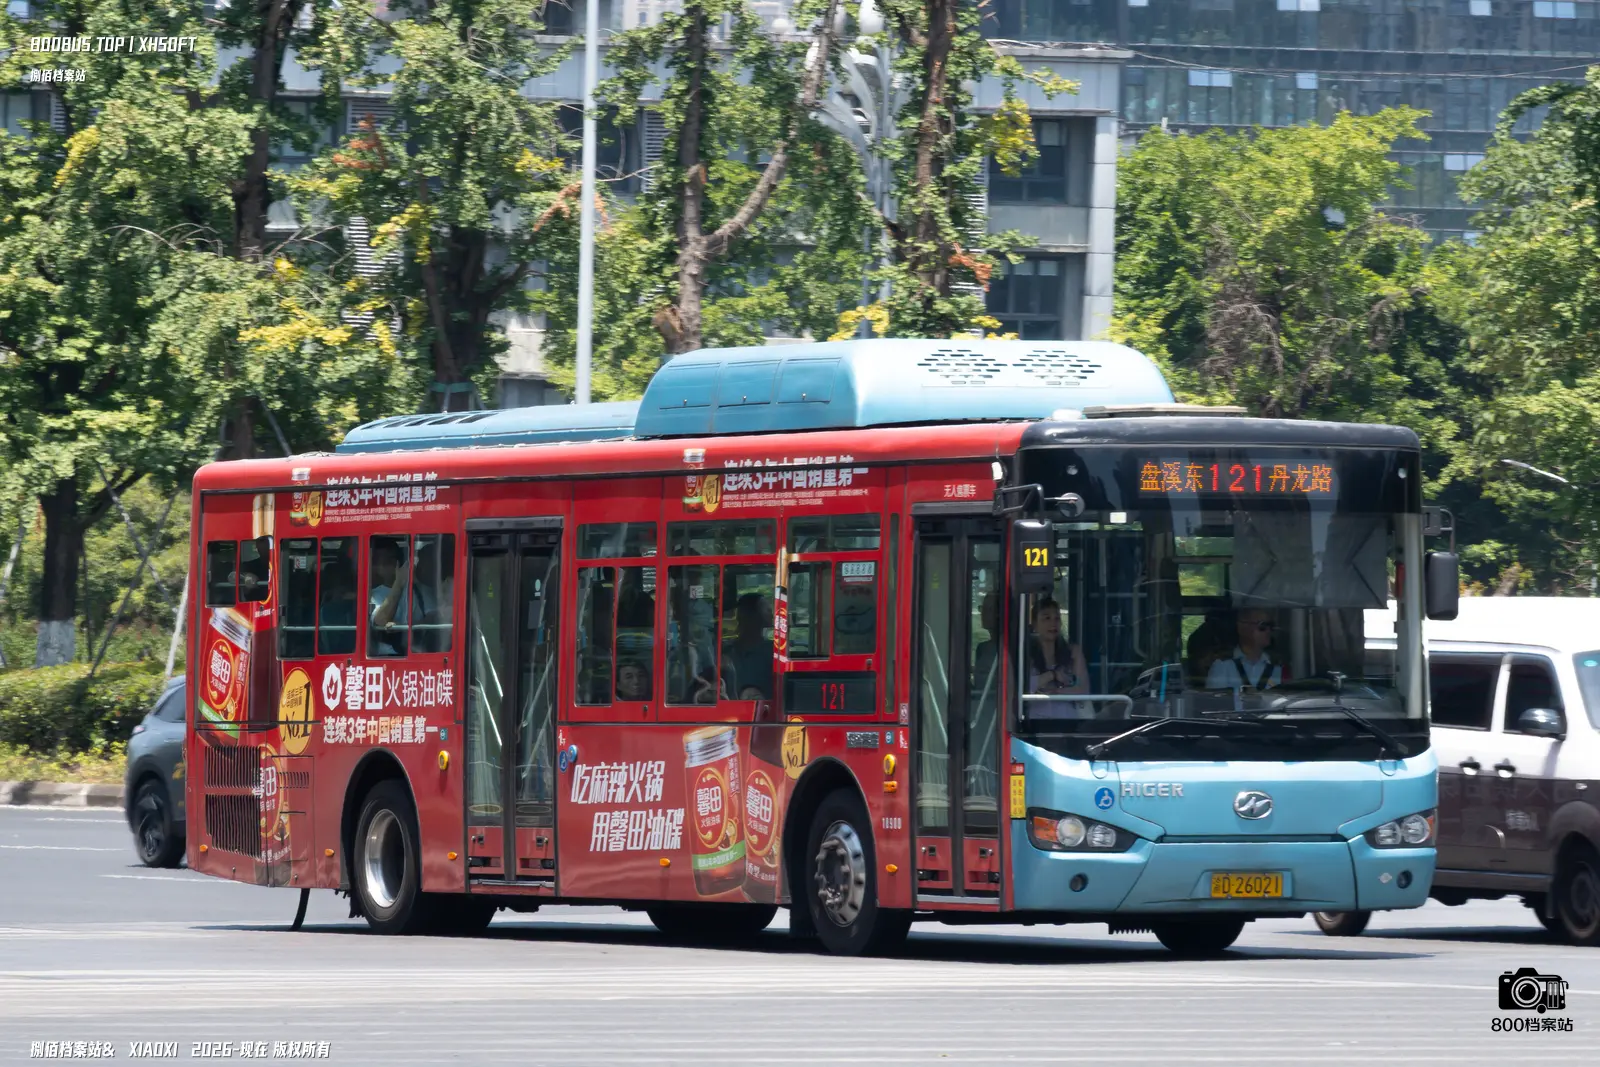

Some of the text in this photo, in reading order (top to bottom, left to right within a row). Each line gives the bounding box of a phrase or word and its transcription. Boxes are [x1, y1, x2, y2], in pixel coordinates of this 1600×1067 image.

[1024, 547, 1048, 567] 121
[821, 683, 845, 710] 121
[323, 715, 438, 744] 连续3年中国销量第一
[570, 760, 665, 804] 吃麻辣火锅
[1120, 782, 1184, 798] HIGER
[697, 786, 722, 816] 馨田
[746, 785, 773, 823] 馨田
[589, 808, 684, 852] 用馨田油碟
